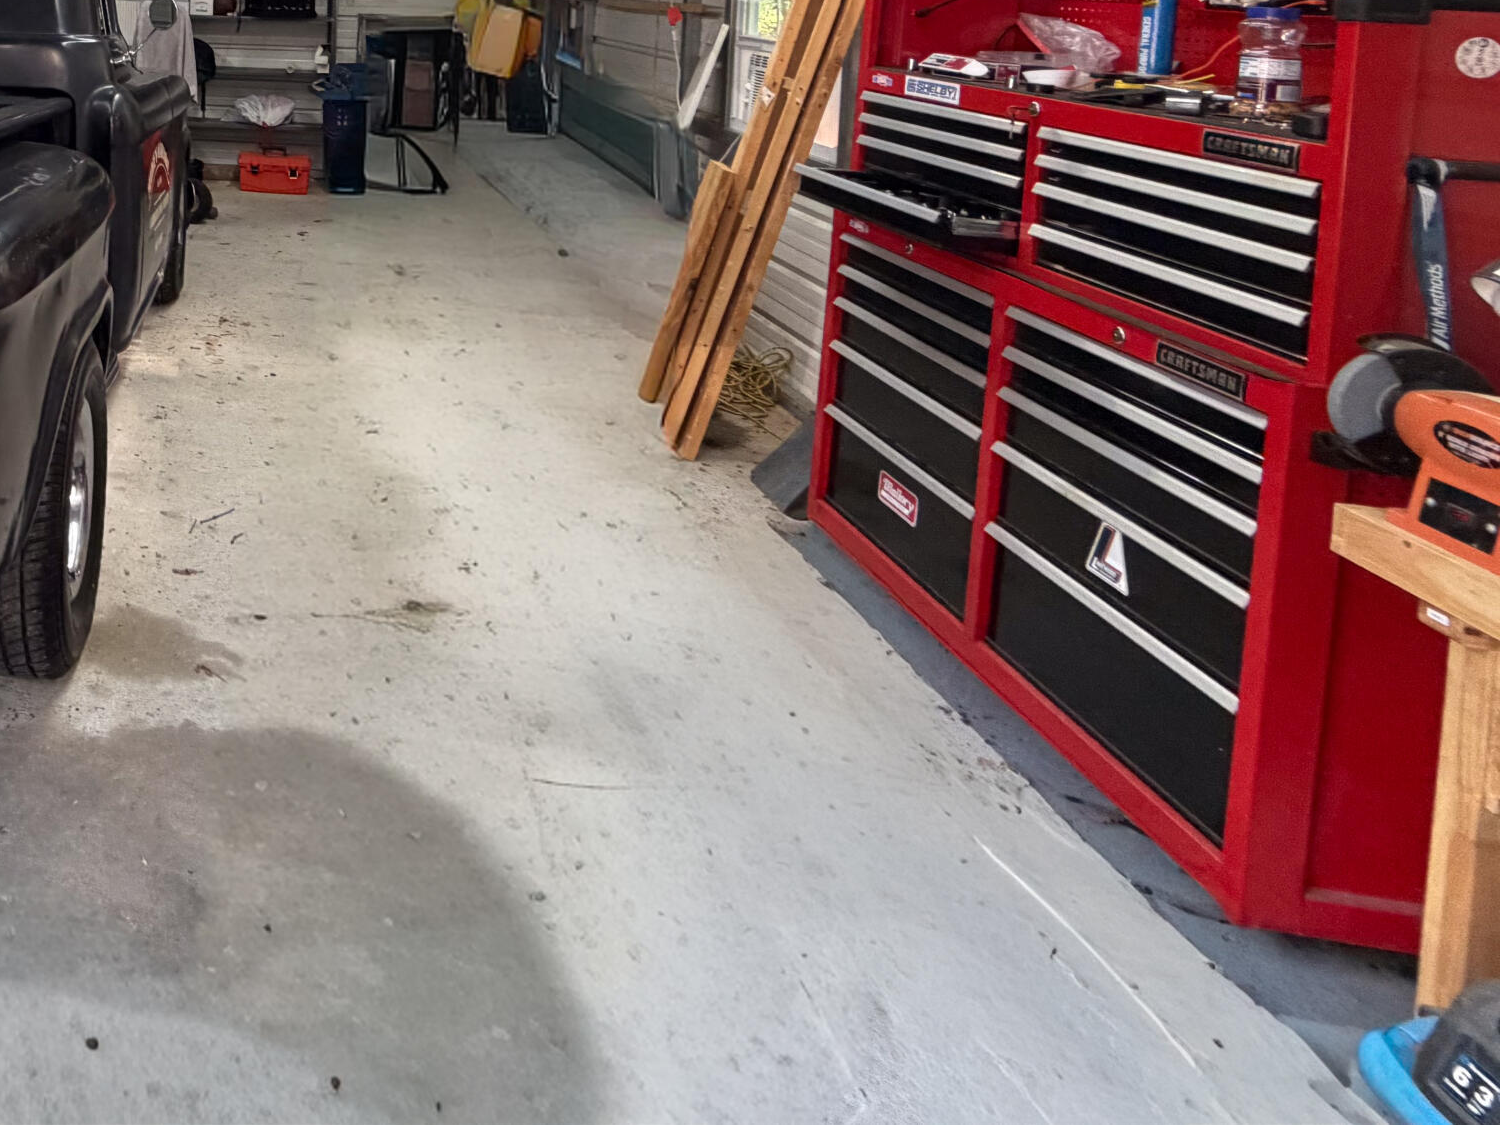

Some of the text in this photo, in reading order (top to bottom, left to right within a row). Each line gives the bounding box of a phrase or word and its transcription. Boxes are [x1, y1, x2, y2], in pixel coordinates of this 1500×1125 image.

[1141, 16, 1152, 46] GENERAL
[917, 80, 953, 100] SHELBY
[1206, 135, 1291, 165] CRAFTSMAN
[1160, 348, 1238, 392] CRAFTSMAN
